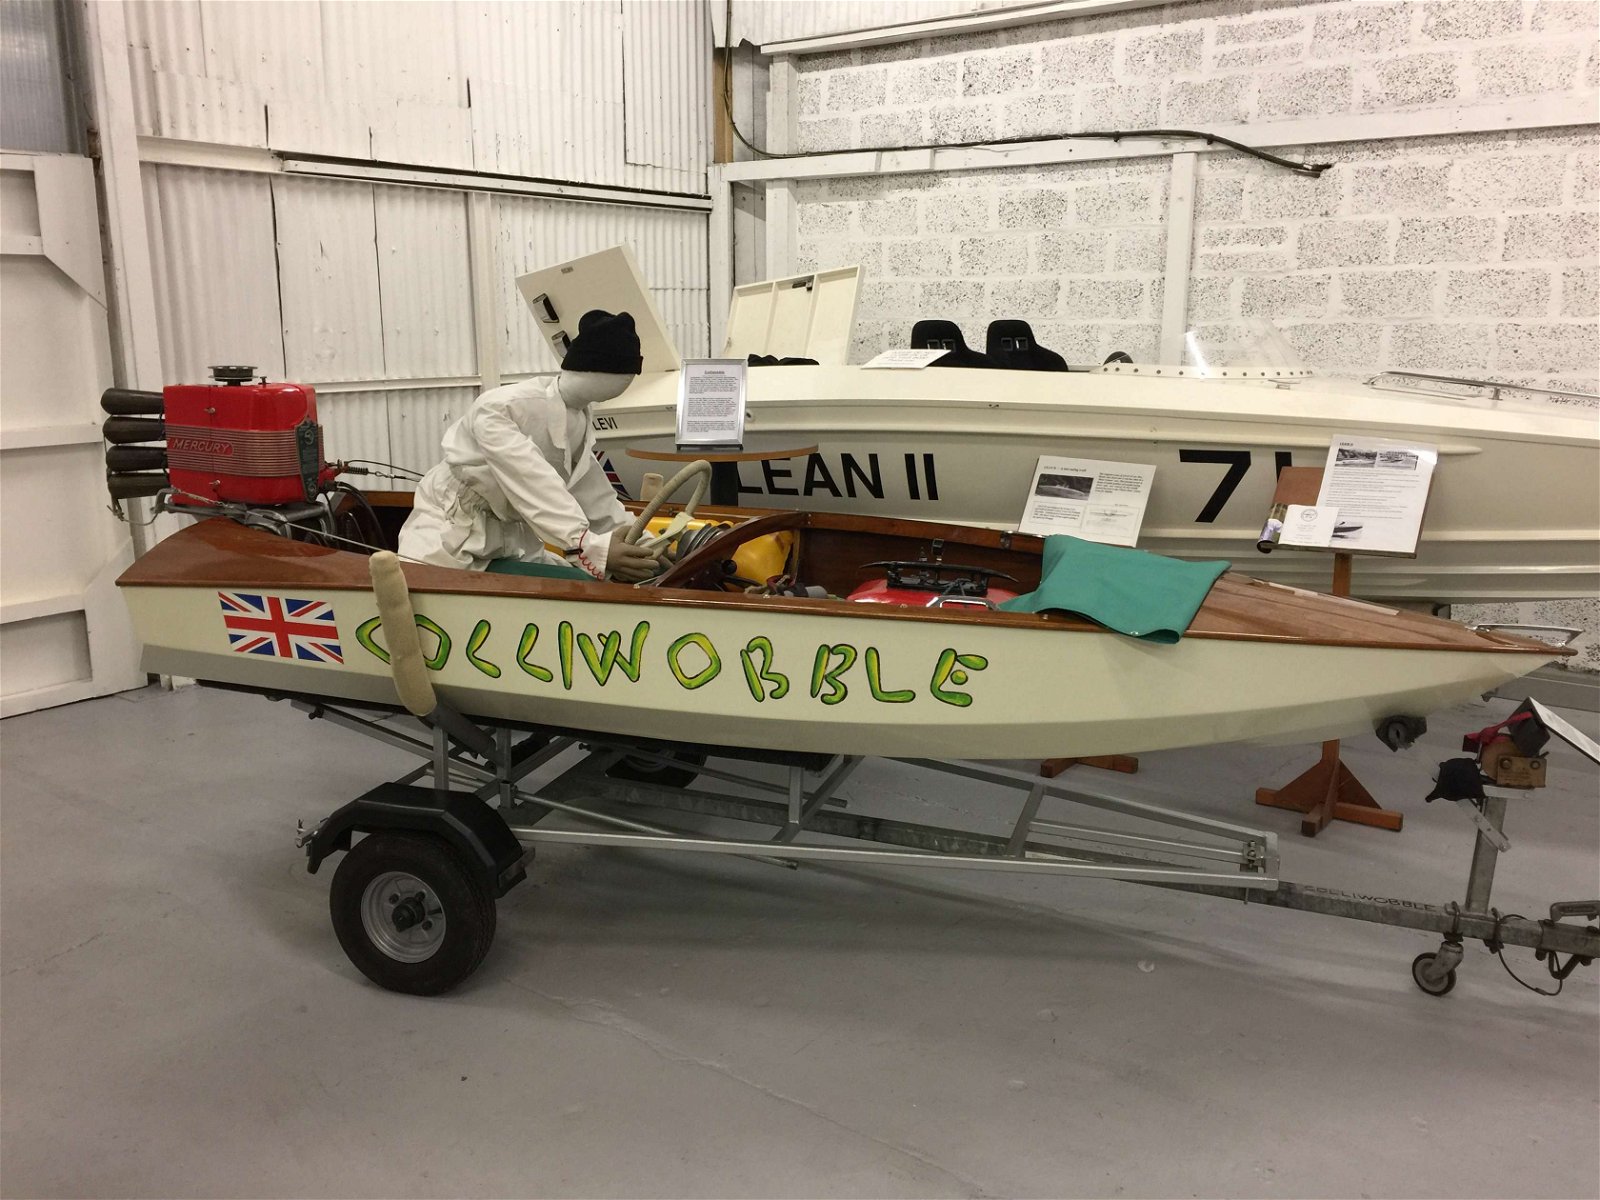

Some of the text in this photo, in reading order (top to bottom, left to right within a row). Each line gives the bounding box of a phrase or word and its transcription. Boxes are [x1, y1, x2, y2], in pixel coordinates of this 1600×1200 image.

[592, 417, 618, 430] LEVI
[173, 439, 230, 454] MERCURY
[904, 453, 939, 500] II
